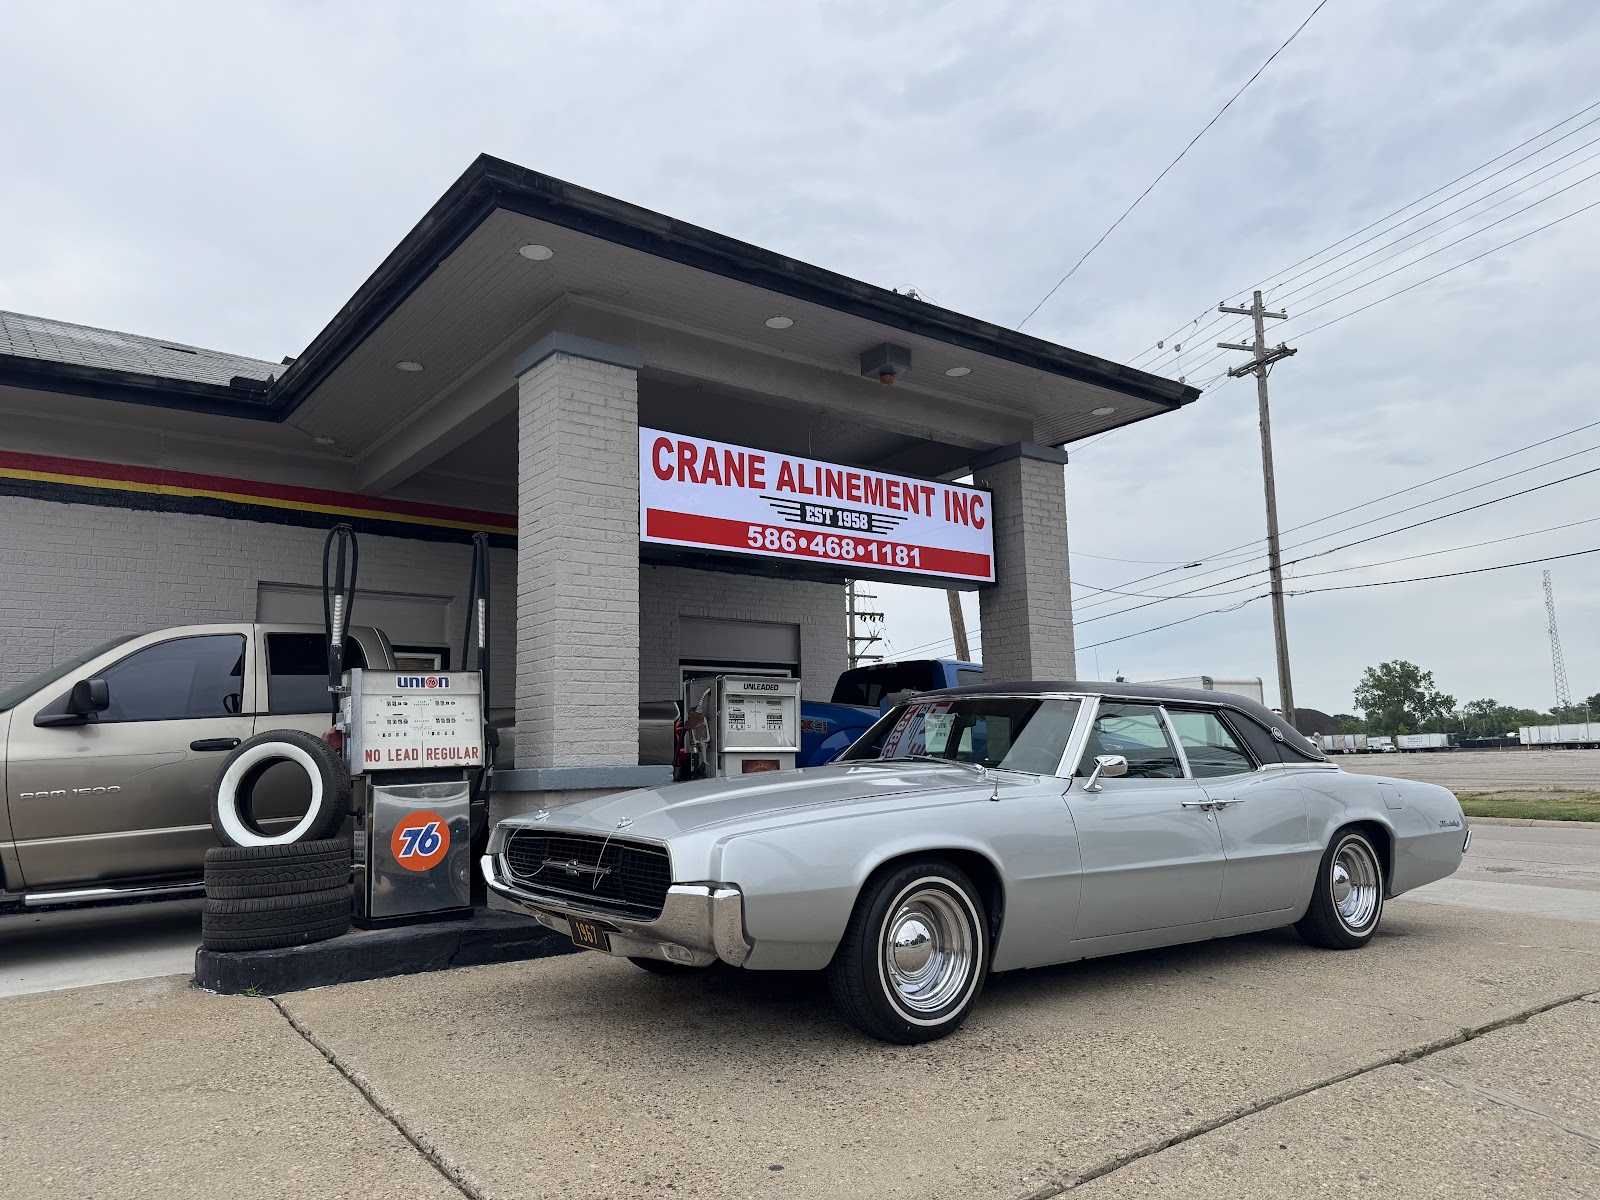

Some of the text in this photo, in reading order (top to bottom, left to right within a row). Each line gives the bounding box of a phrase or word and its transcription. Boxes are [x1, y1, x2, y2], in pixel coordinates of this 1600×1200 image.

[652, 436, 985, 530] CRANE ALINEMENT INC
[805, 505, 869, 530] EST 1958
[743, 683, 779, 691] UNLEADED
[365, 746, 479, 763] NO LEAD REGULAR
[72, 785, 121, 796] 1500
[398, 821, 442, 858] 76
[575, 922, 598, 945] 1967
